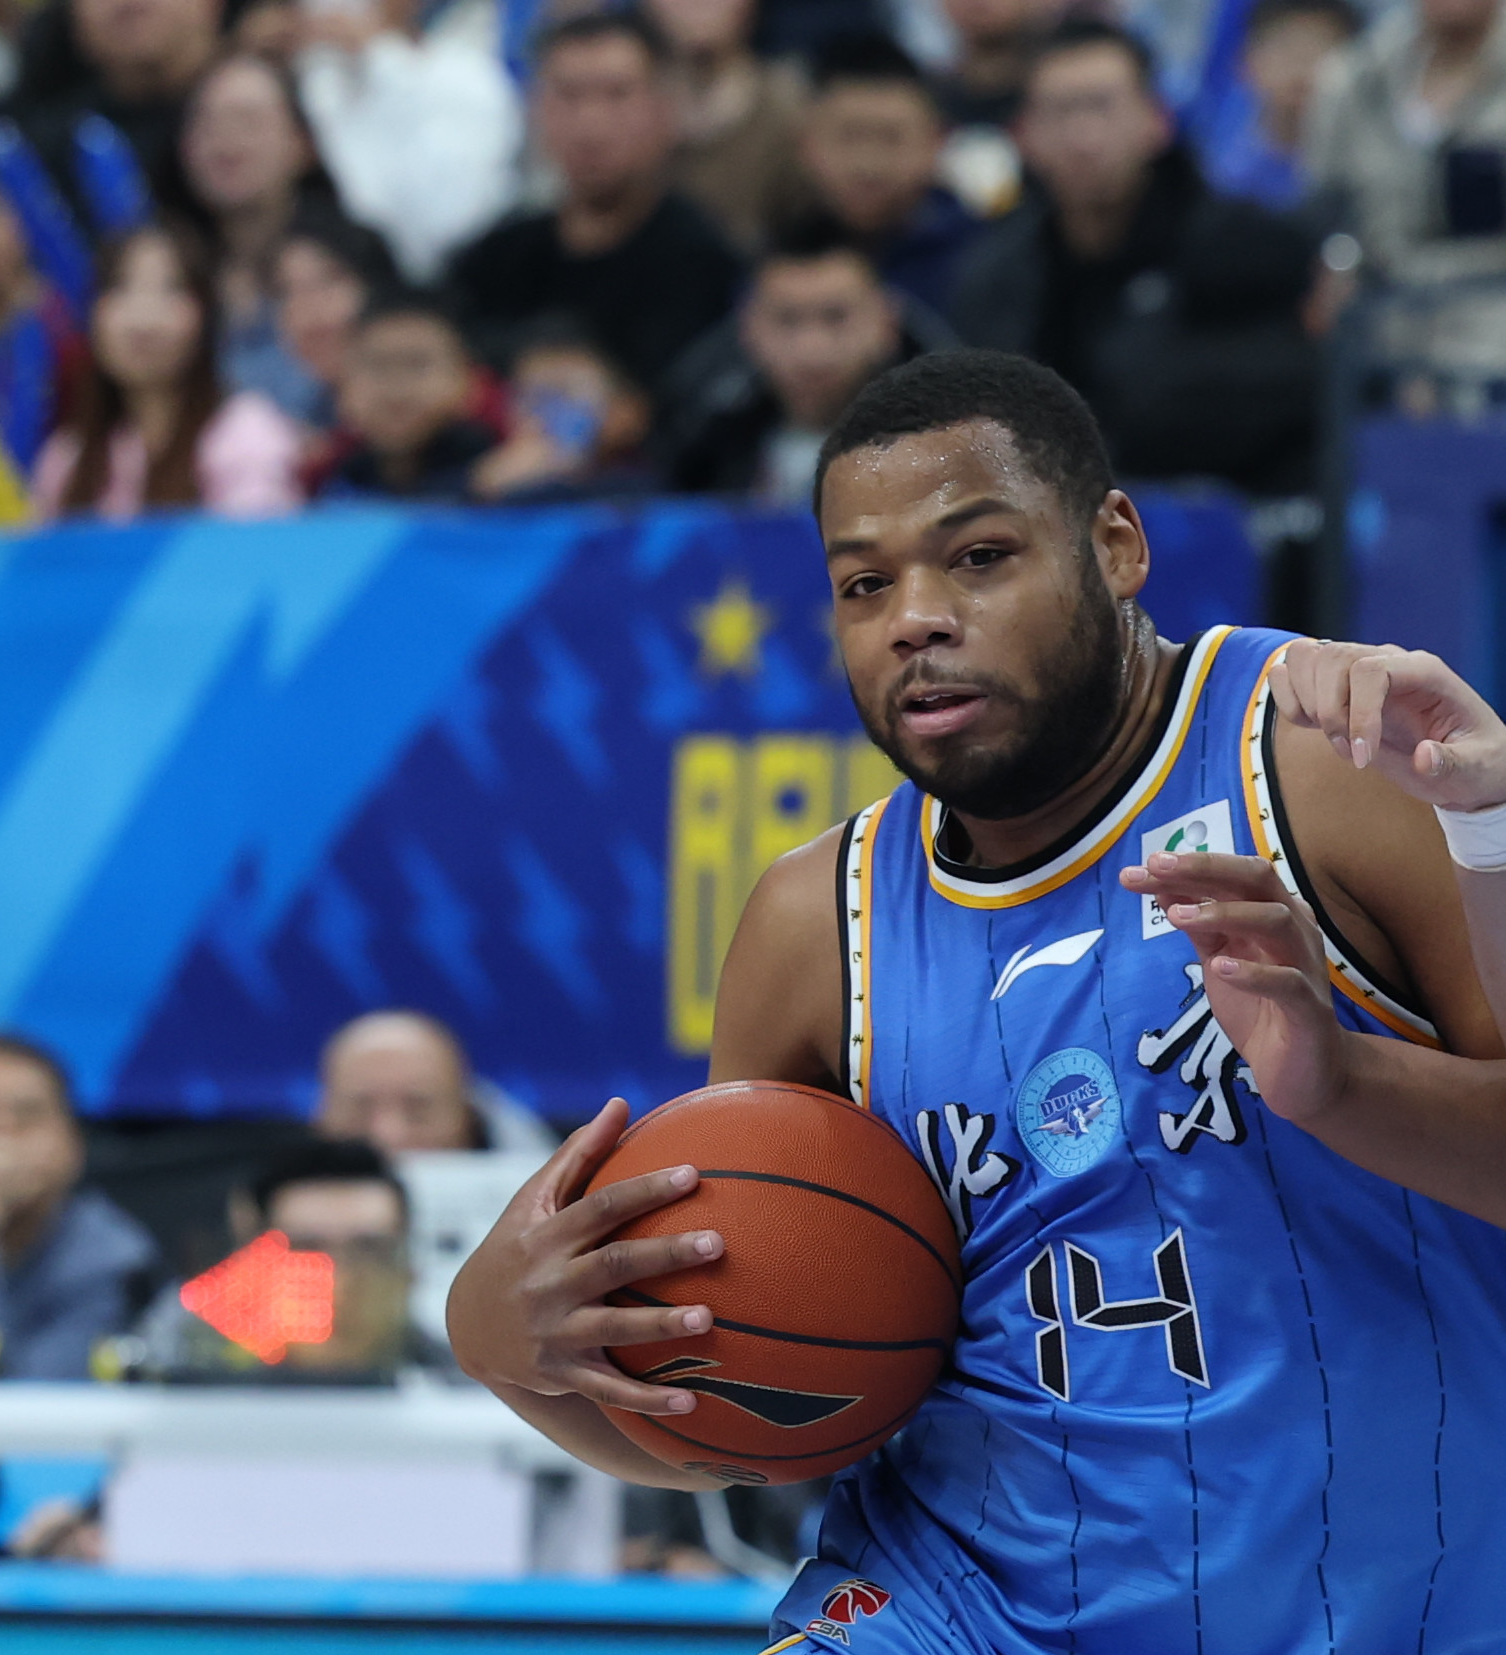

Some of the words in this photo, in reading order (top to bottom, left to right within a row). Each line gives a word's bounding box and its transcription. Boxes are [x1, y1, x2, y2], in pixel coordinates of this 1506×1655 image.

[1039, 1079, 1101, 1119] DUCKS
[1025, 1227, 1210, 1402] 14
[805, 1619, 851, 1646] CBA
